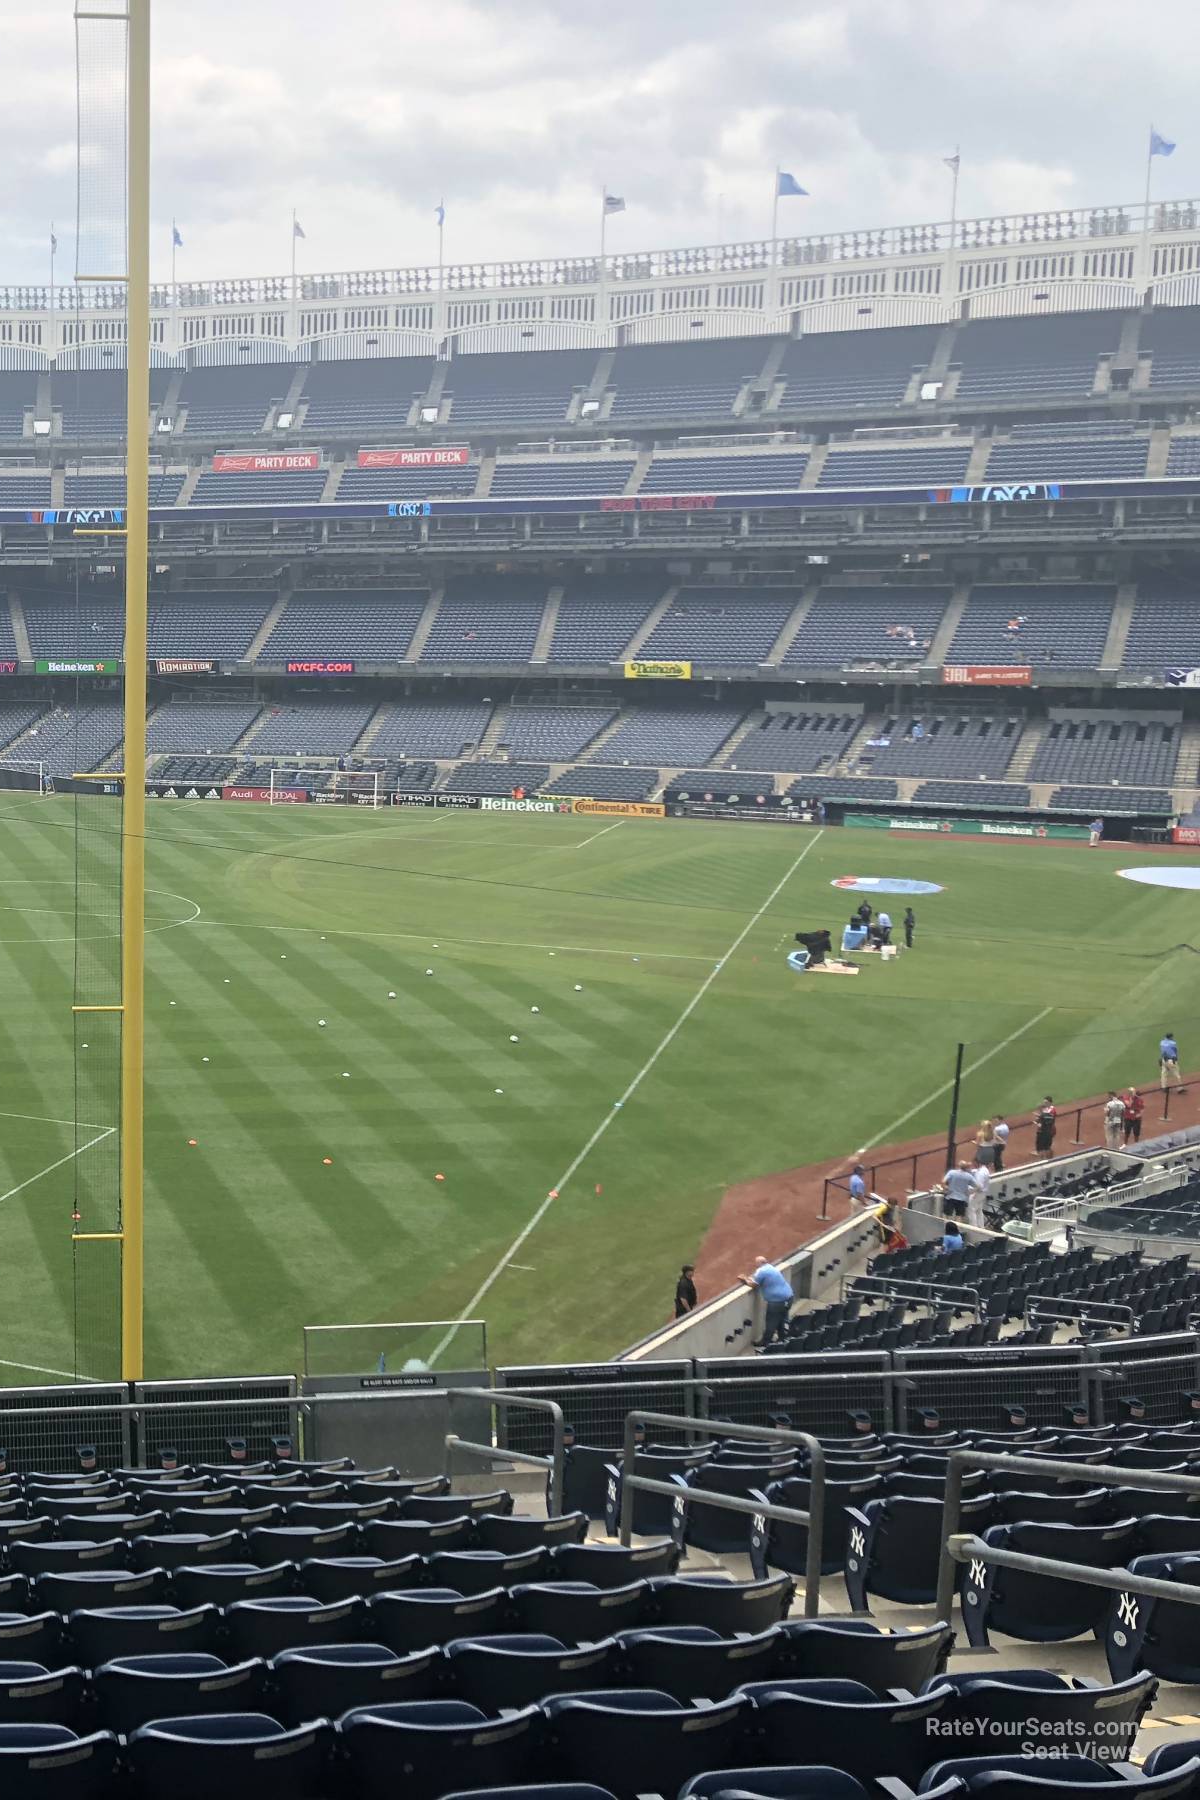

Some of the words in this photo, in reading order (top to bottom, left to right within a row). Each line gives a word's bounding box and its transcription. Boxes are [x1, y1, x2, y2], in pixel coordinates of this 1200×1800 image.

[255, 457, 284, 468] PARTY
[286, 456, 312, 467] DECK
[401, 452, 429, 463] PARTY
[434, 451, 462, 463] DECK
[48, 662, 95, 672] Heineken
[159, 662, 212, 673] ADMIRATION
[287, 662, 352, 672] NYCFC.COM
[945, 668, 972, 682] JBL
[230, 790, 253, 798] Audi
[395, 794, 432, 802] ETIHAD
[438, 796, 477, 804] ETIHAD
[481, 797, 554, 812] Heineken
[575, 801, 629, 813] Continental
[640, 806, 662, 815] TIRE
[890, 819, 938, 830] Heineken
[982, 824, 1034, 835] Heineken
[850, 1526, 866, 1558] NY
[969, 1558, 987, 1590] NY
[1117, 1592, 1140, 1630] NY
